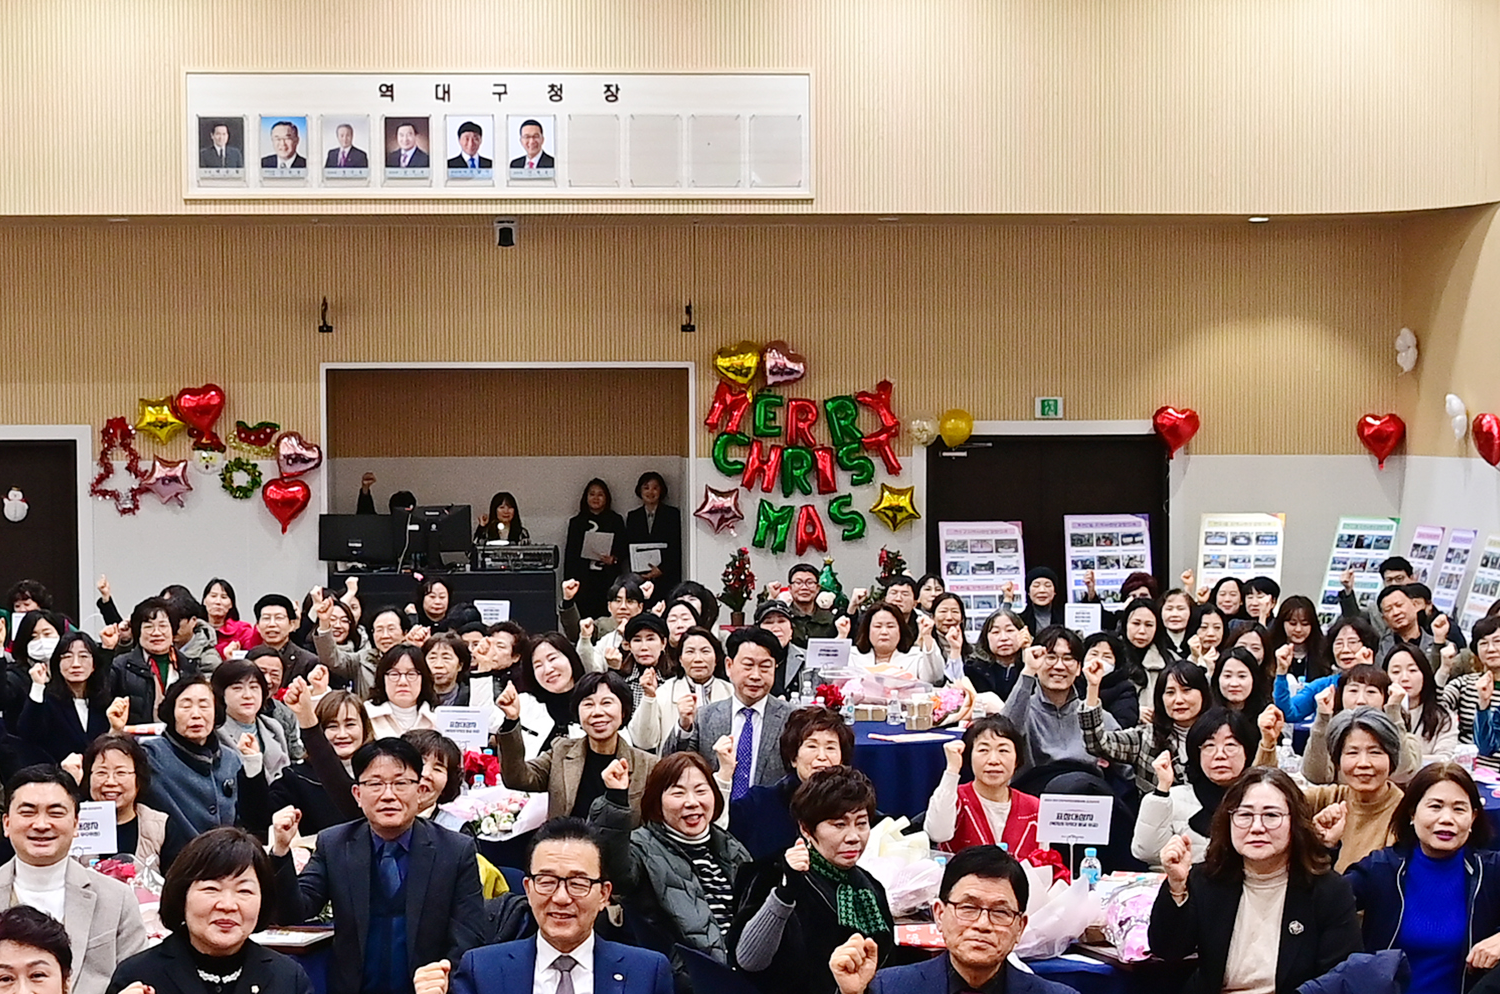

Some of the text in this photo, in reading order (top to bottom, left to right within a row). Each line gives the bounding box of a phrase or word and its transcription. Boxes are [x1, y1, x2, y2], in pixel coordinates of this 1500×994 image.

[704, 379, 902, 476] MERRY
[712, 431, 875, 498] CHRIS
[752, 493, 867, 556] MAS
